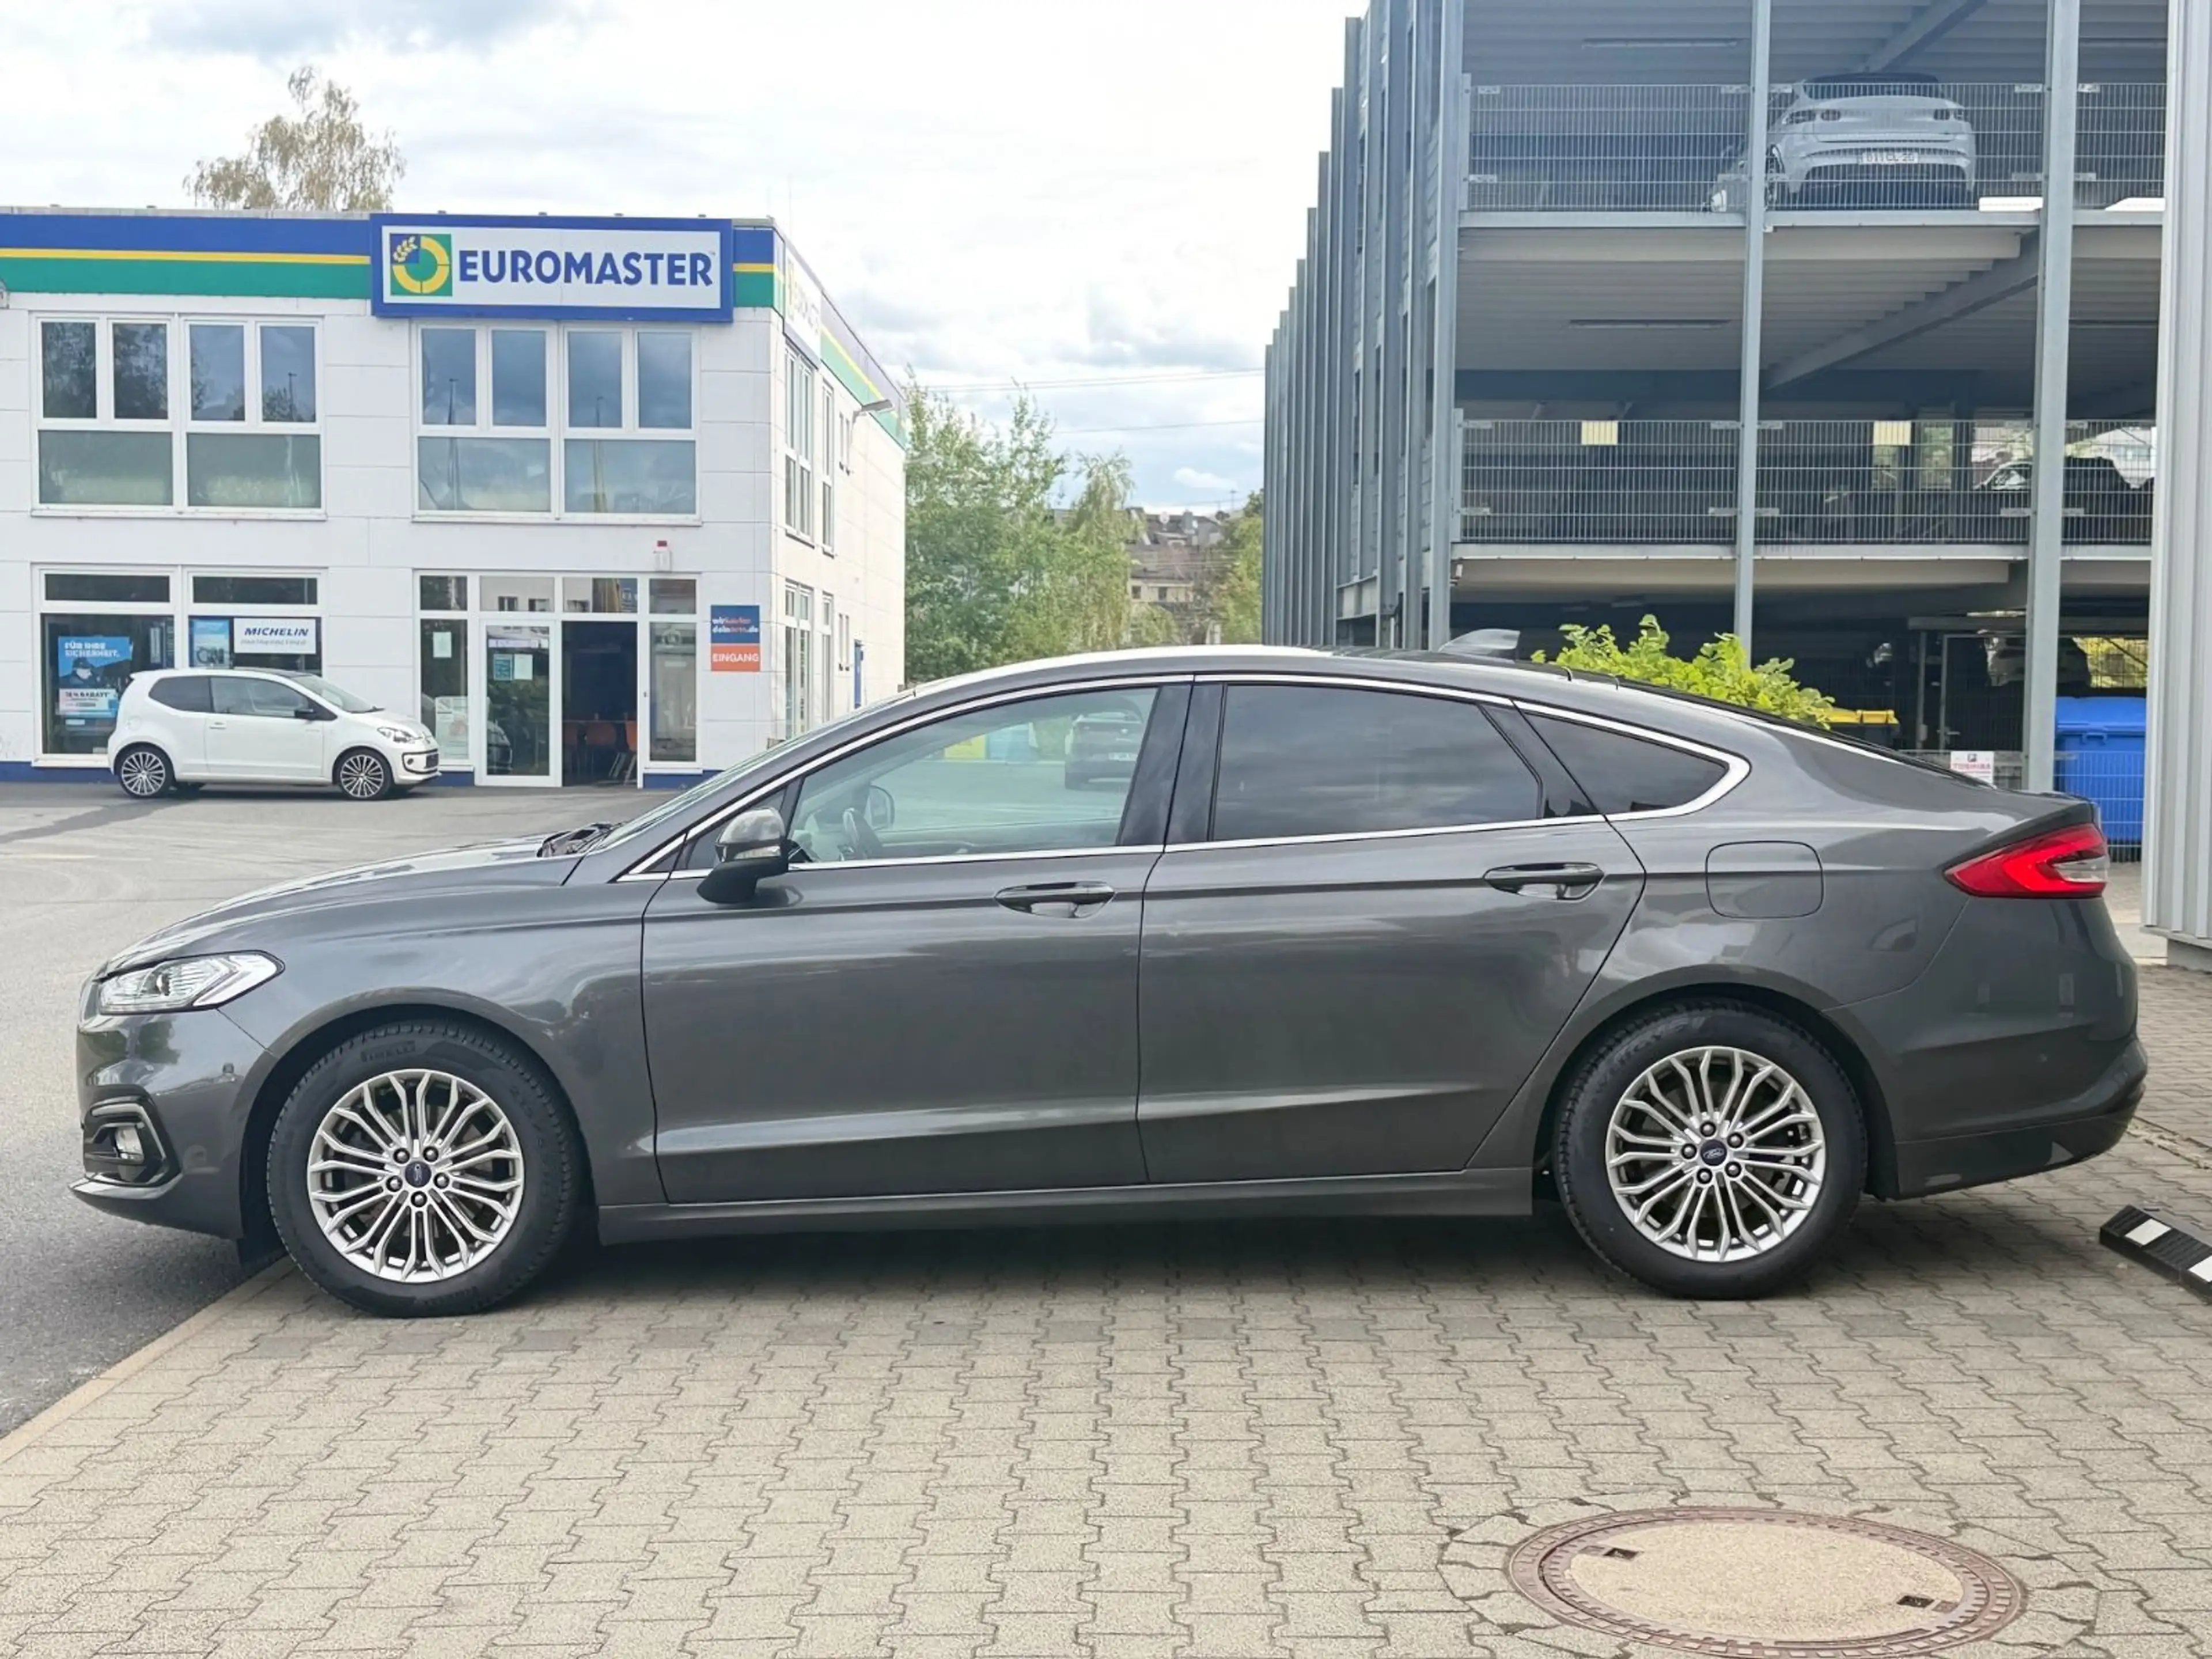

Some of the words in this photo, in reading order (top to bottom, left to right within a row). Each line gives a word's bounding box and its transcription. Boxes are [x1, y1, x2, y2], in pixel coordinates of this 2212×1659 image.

[459, 250, 713, 286] EUROMASTER
[244, 627, 309, 637] MICHELIN
[713, 653, 759, 662] EINGANG
